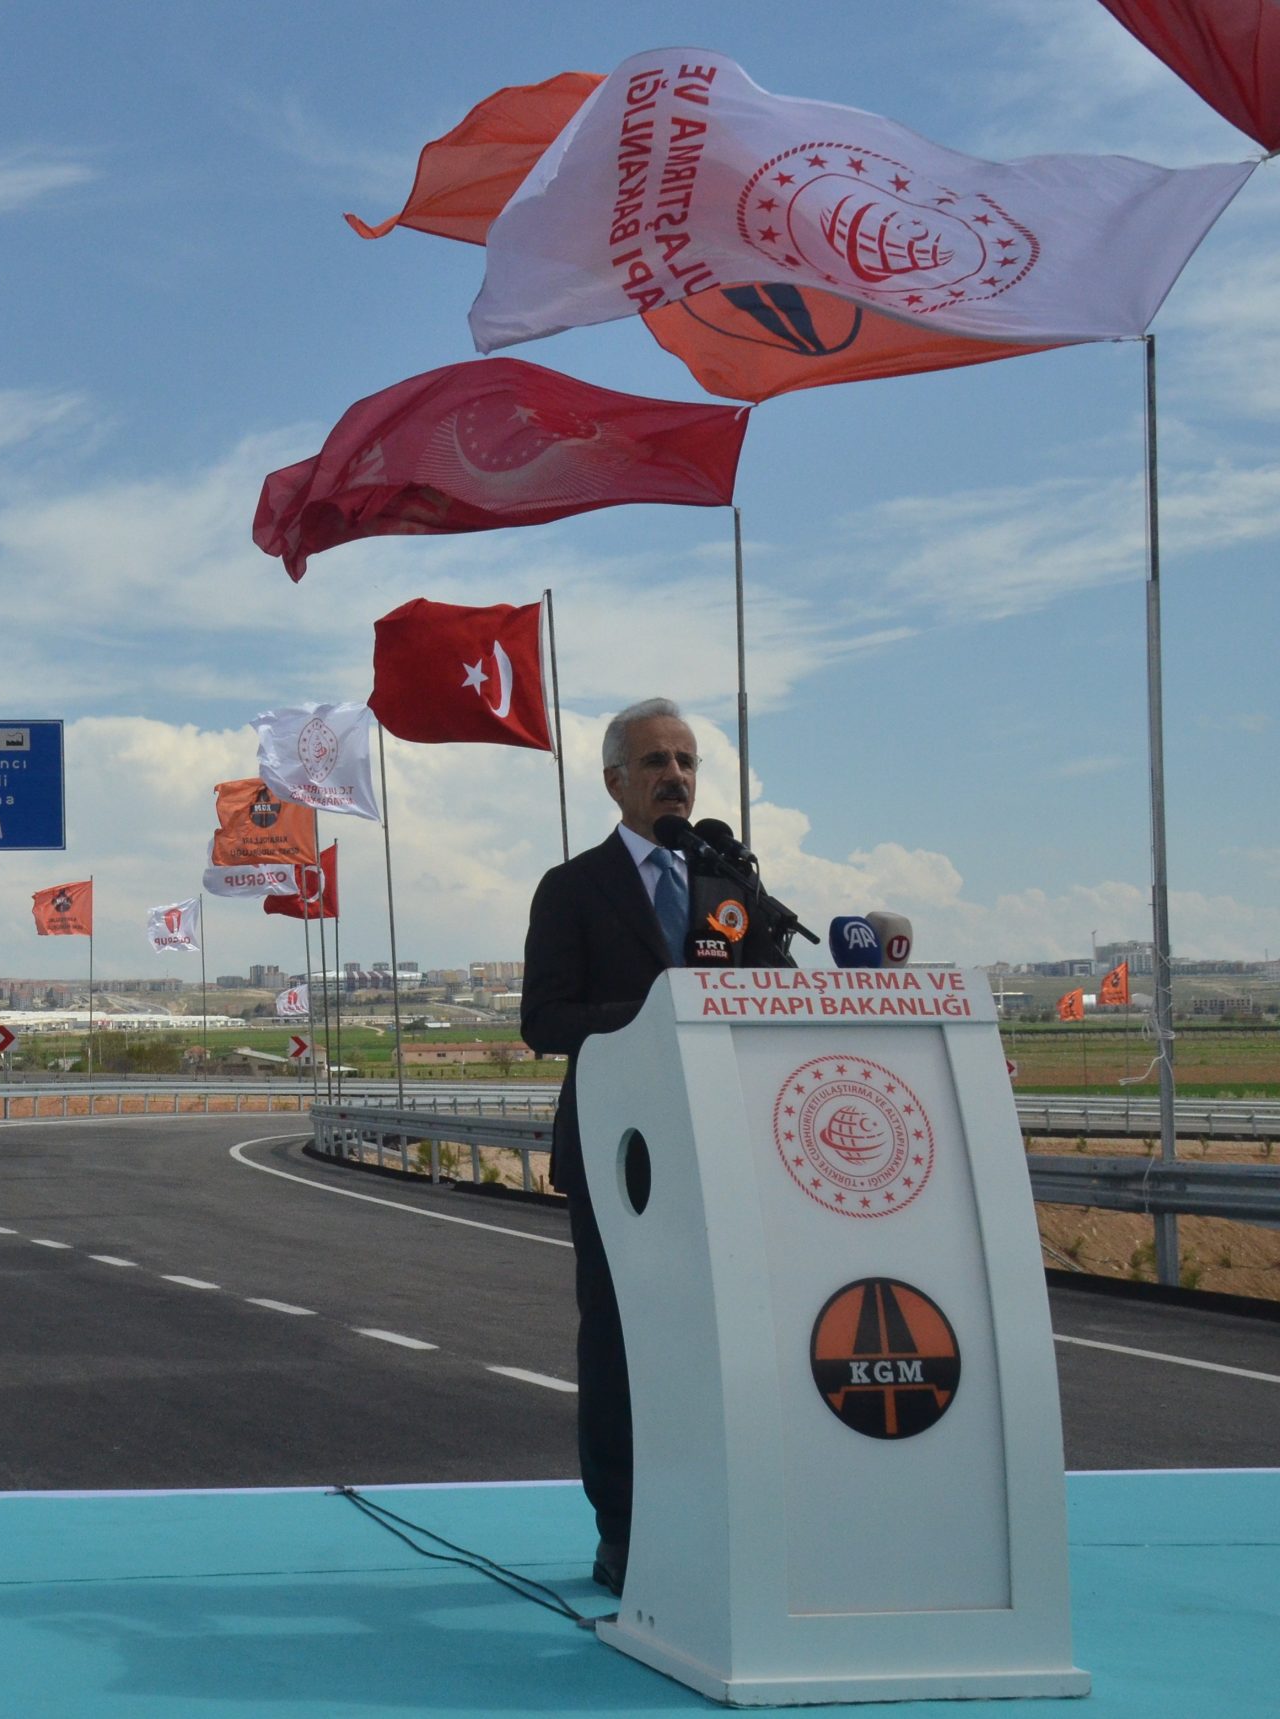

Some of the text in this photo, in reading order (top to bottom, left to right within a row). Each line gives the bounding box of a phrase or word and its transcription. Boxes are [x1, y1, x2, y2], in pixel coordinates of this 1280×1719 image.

[696, 939, 726, 950] TRT
[697, 950, 728, 959] HABER
[694, 971, 966, 994] T.C. ULAŞTIRMA VE
[702, 993, 971, 1017] ALTYAPI BAKANLIĞI
[873, 1096, 887, 1107] VE
[849, 1360, 924, 1383] KGM
